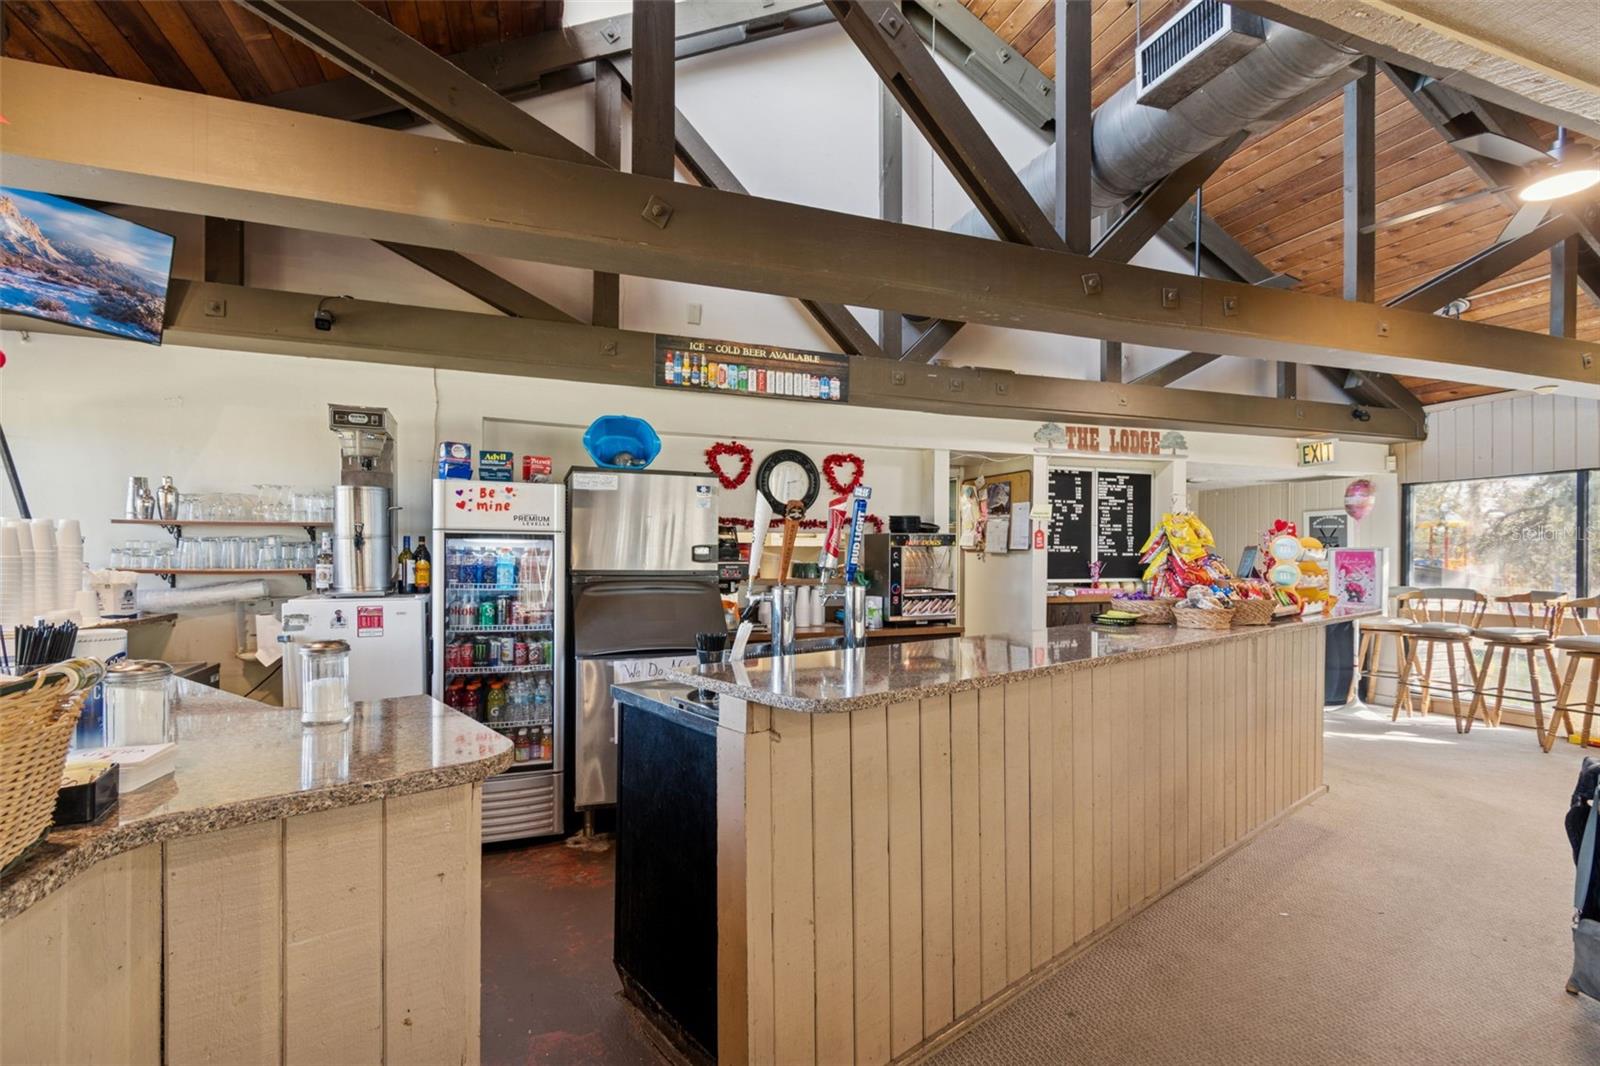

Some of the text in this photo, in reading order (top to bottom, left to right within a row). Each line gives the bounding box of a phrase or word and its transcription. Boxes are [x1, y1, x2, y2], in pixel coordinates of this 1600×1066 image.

[689, 342, 705, 351] ICE
[715, 344, 741, 355] COLD
[742, 348, 767, 358] BEER
[769, 351, 820, 364] AVAILABLE
[1065, 426, 1160, 455] THE LODGE
[484, 453, 506, 461] Advil
[1302, 442, 1333, 464] EXIT
[479, 487, 496, 498] Be
[476, 501, 511, 512] mine
[624, 663, 641, 678] We
[648, 662, 664, 677] Do
